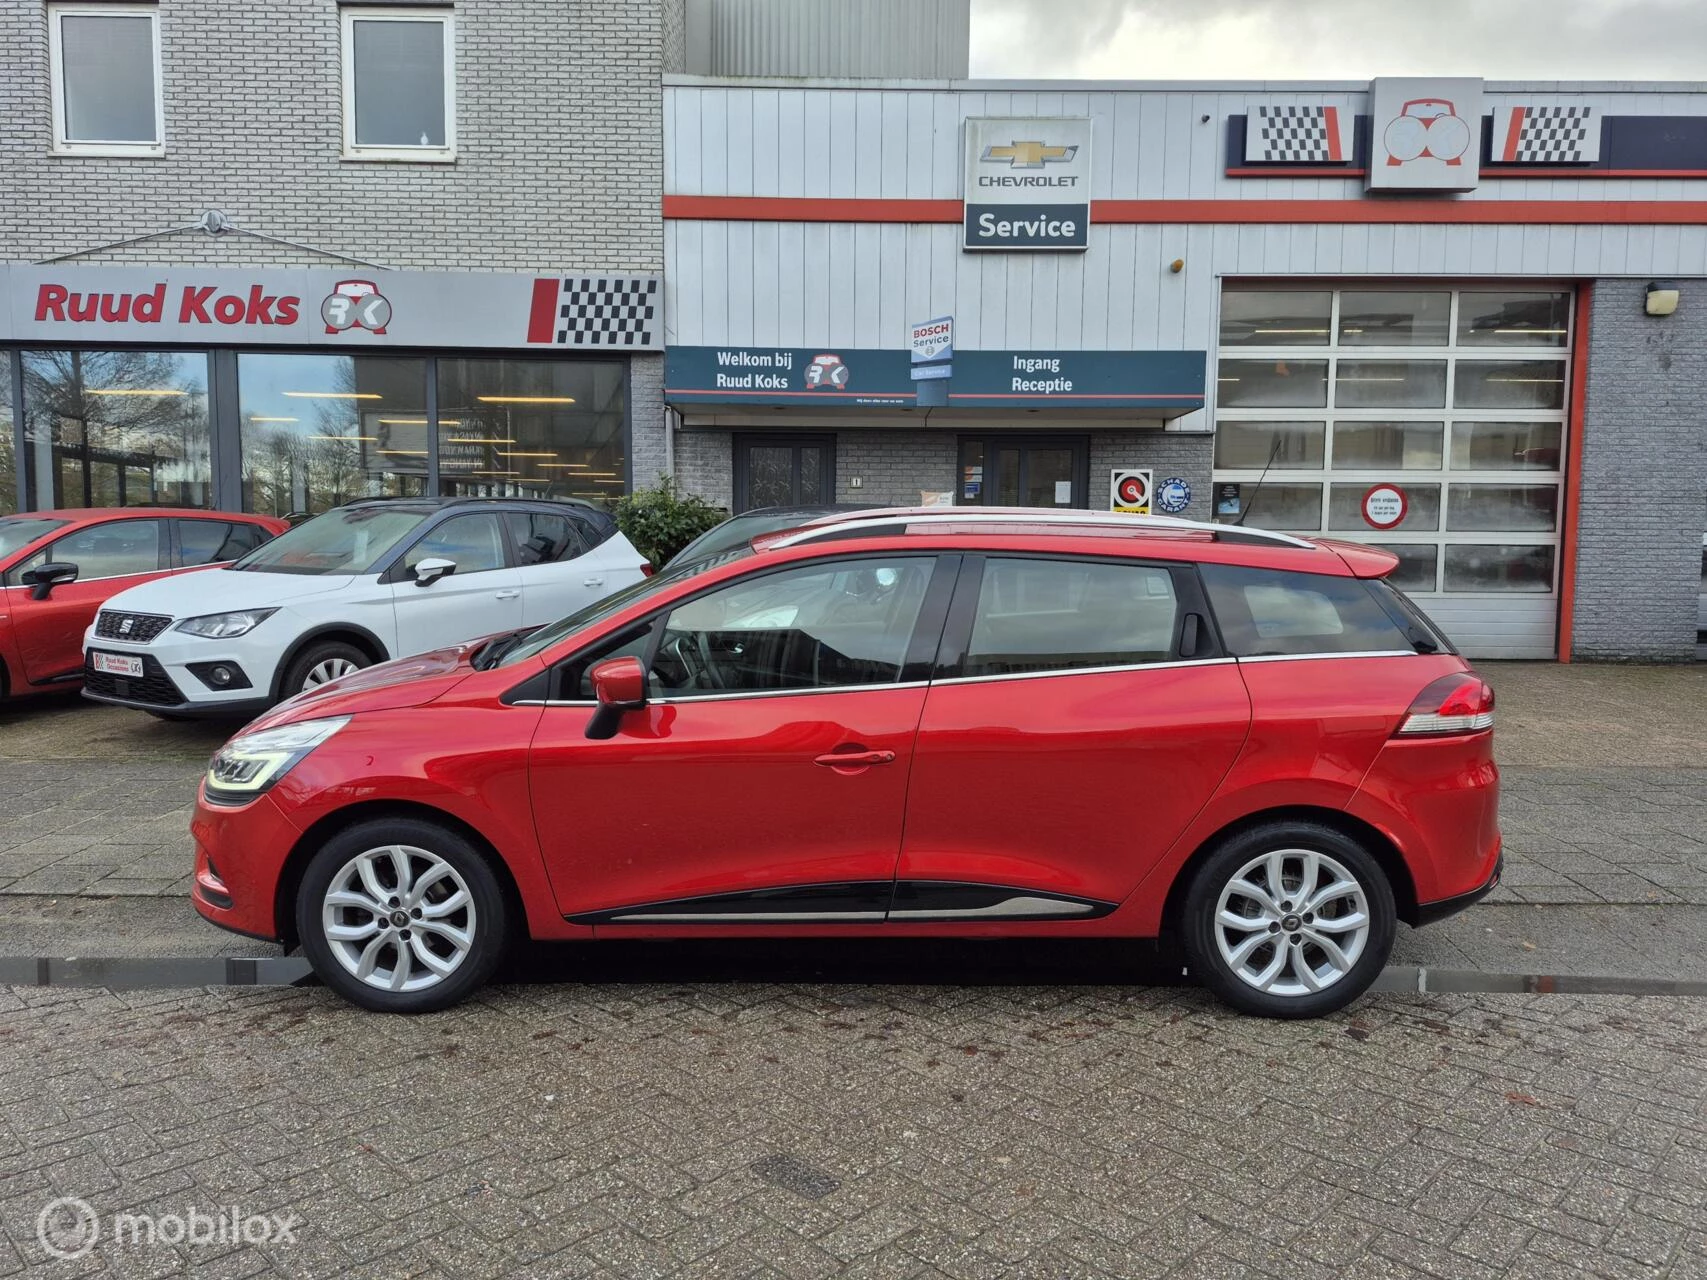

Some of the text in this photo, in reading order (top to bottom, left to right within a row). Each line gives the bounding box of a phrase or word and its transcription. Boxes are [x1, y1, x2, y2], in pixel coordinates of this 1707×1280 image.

[979, 176, 1079, 187] CHEVROLET
[979, 213, 1075, 237] Service
[34, 283, 300, 325] Ruud Koks
[913, 324, 949, 339] BOSCH
[913, 335, 949, 348] Service
[717, 352, 792, 370] Welkom bij
[1013, 355, 1060, 373] Ingang
[717, 373, 788, 389] Ruud Koks
[1012, 377, 1073, 394] Receptie
[1157, 478, 1189, 493] SCHADE
